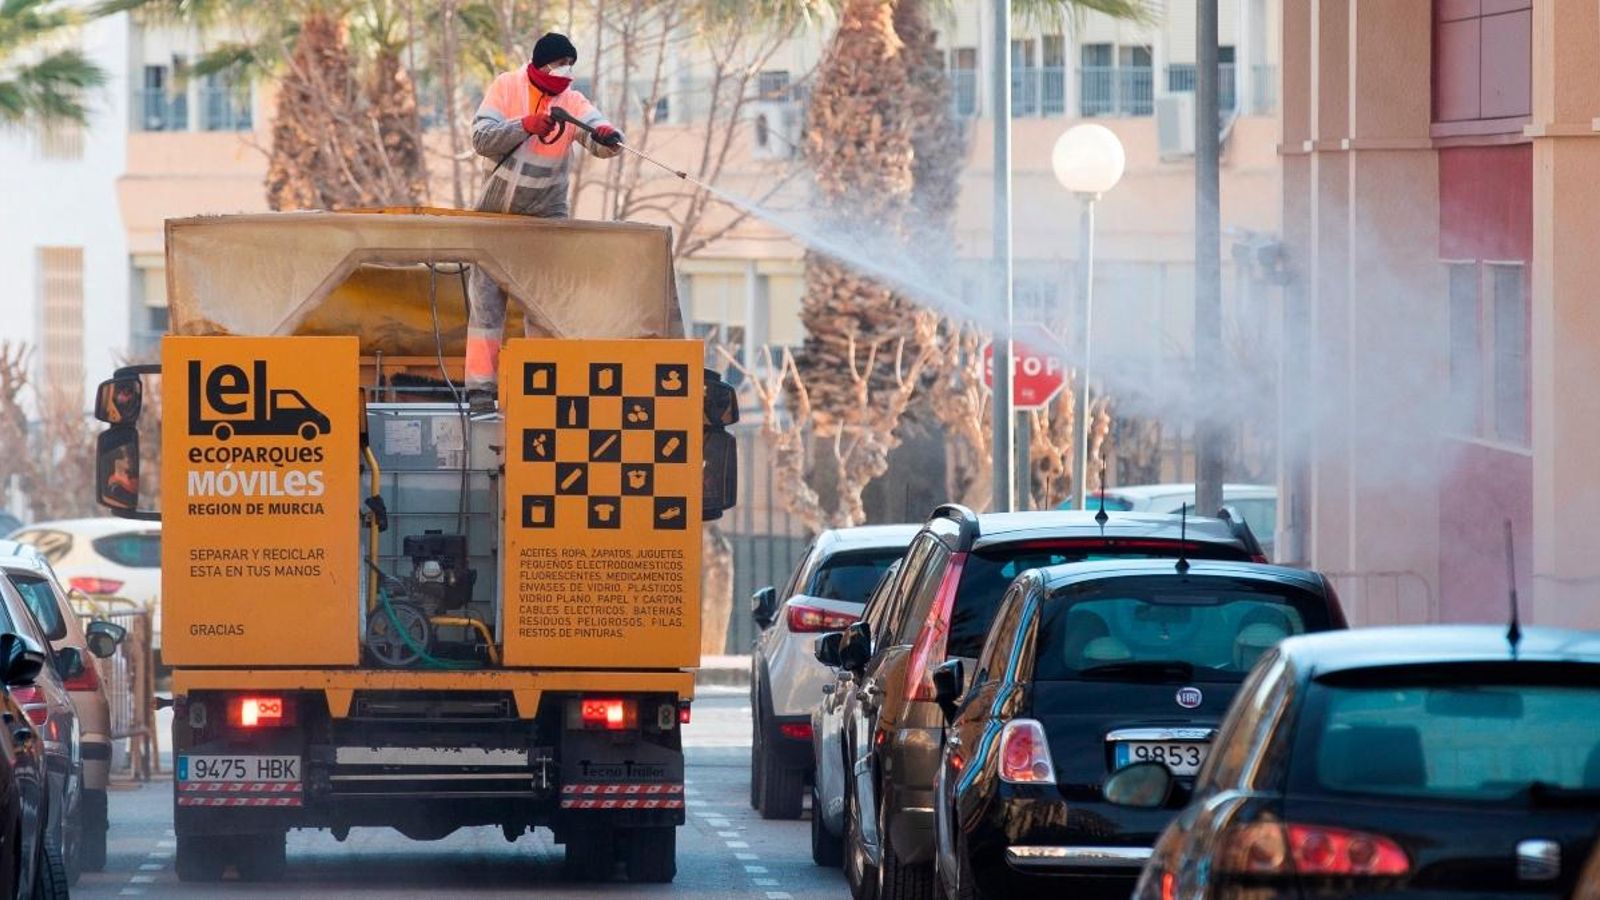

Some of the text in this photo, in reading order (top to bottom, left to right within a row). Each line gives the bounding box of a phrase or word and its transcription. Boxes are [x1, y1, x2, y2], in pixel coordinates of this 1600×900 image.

[188, 503, 325, 515] REGION DE MURCIA
[190, 548, 325, 561] SEPARAR Y RECICLAR
[190, 565, 321, 577] ESTA EN TUS MANOS
[519, 582, 566, 592] ENVASES
[570, 582, 584, 592] DE
[519, 593, 553, 603] VIDRIO
[597, 594, 629, 604] PAPEL
[633, 595, 639, 604] Y
[519, 605, 559, 615] CABLES
[190, 624, 244, 636] GRACIAS
[519, 628, 556, 638] RESTOS
[559, 628, 571, 638] DE
[1135, 745, 1200, 767] 9853
[195, 759, 297, 779] 9475 HBK
